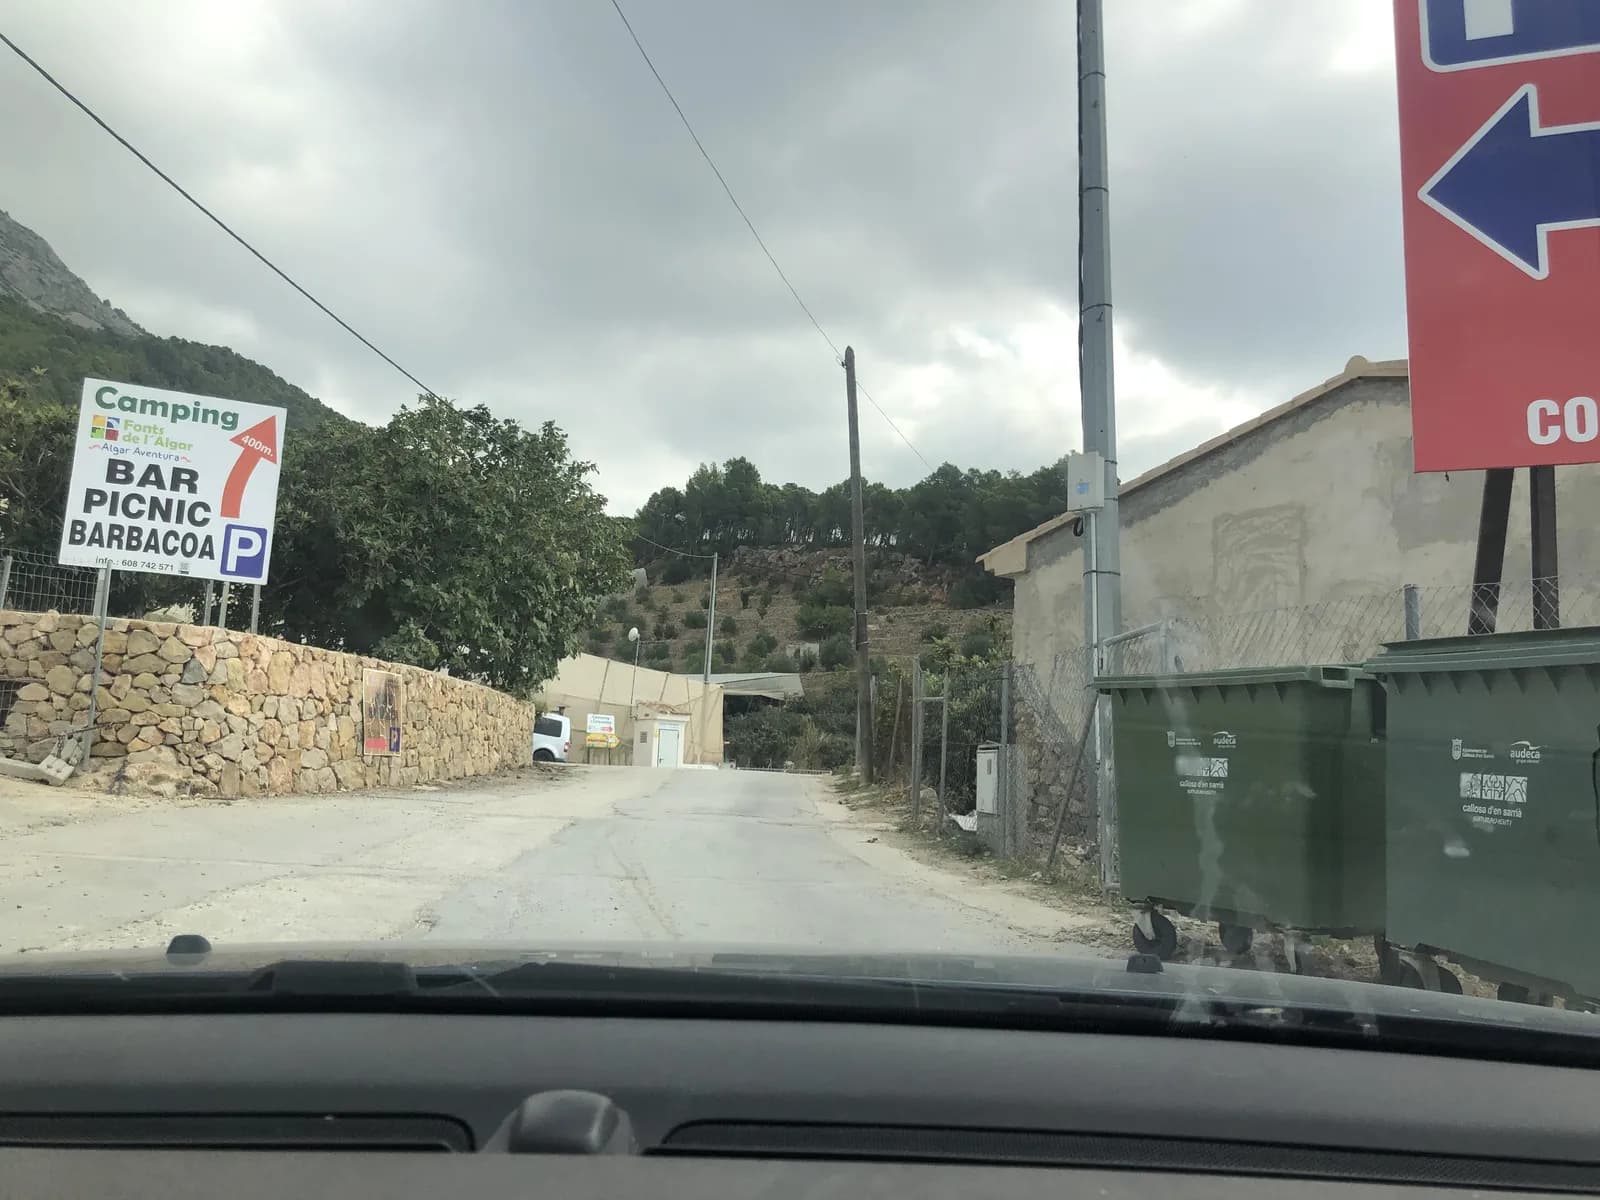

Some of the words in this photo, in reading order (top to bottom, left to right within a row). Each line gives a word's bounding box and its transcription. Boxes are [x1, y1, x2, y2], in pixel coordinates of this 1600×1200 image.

[95, 386, 240, 431] Camping
[122, 432, 140, 444] de
[124, 419, 165, 436] Fonts
[101, 442, 131, 456] Algar
[133, 447, 180, 462] Aventura
[241, 435, 273, 457] 400m.
[105, 458, 200, 495] BAR
[83, 488, 212, 528] PICNIC
[68, 520, 215, 561] BARBACOA
[226, 528, 262, 572] P
[121, 559, 138, 568] 608
[140, 561, 157, 570] 742
[158, 563, 174, 572] 571
[1510, 748, 1540, 759] audeca
